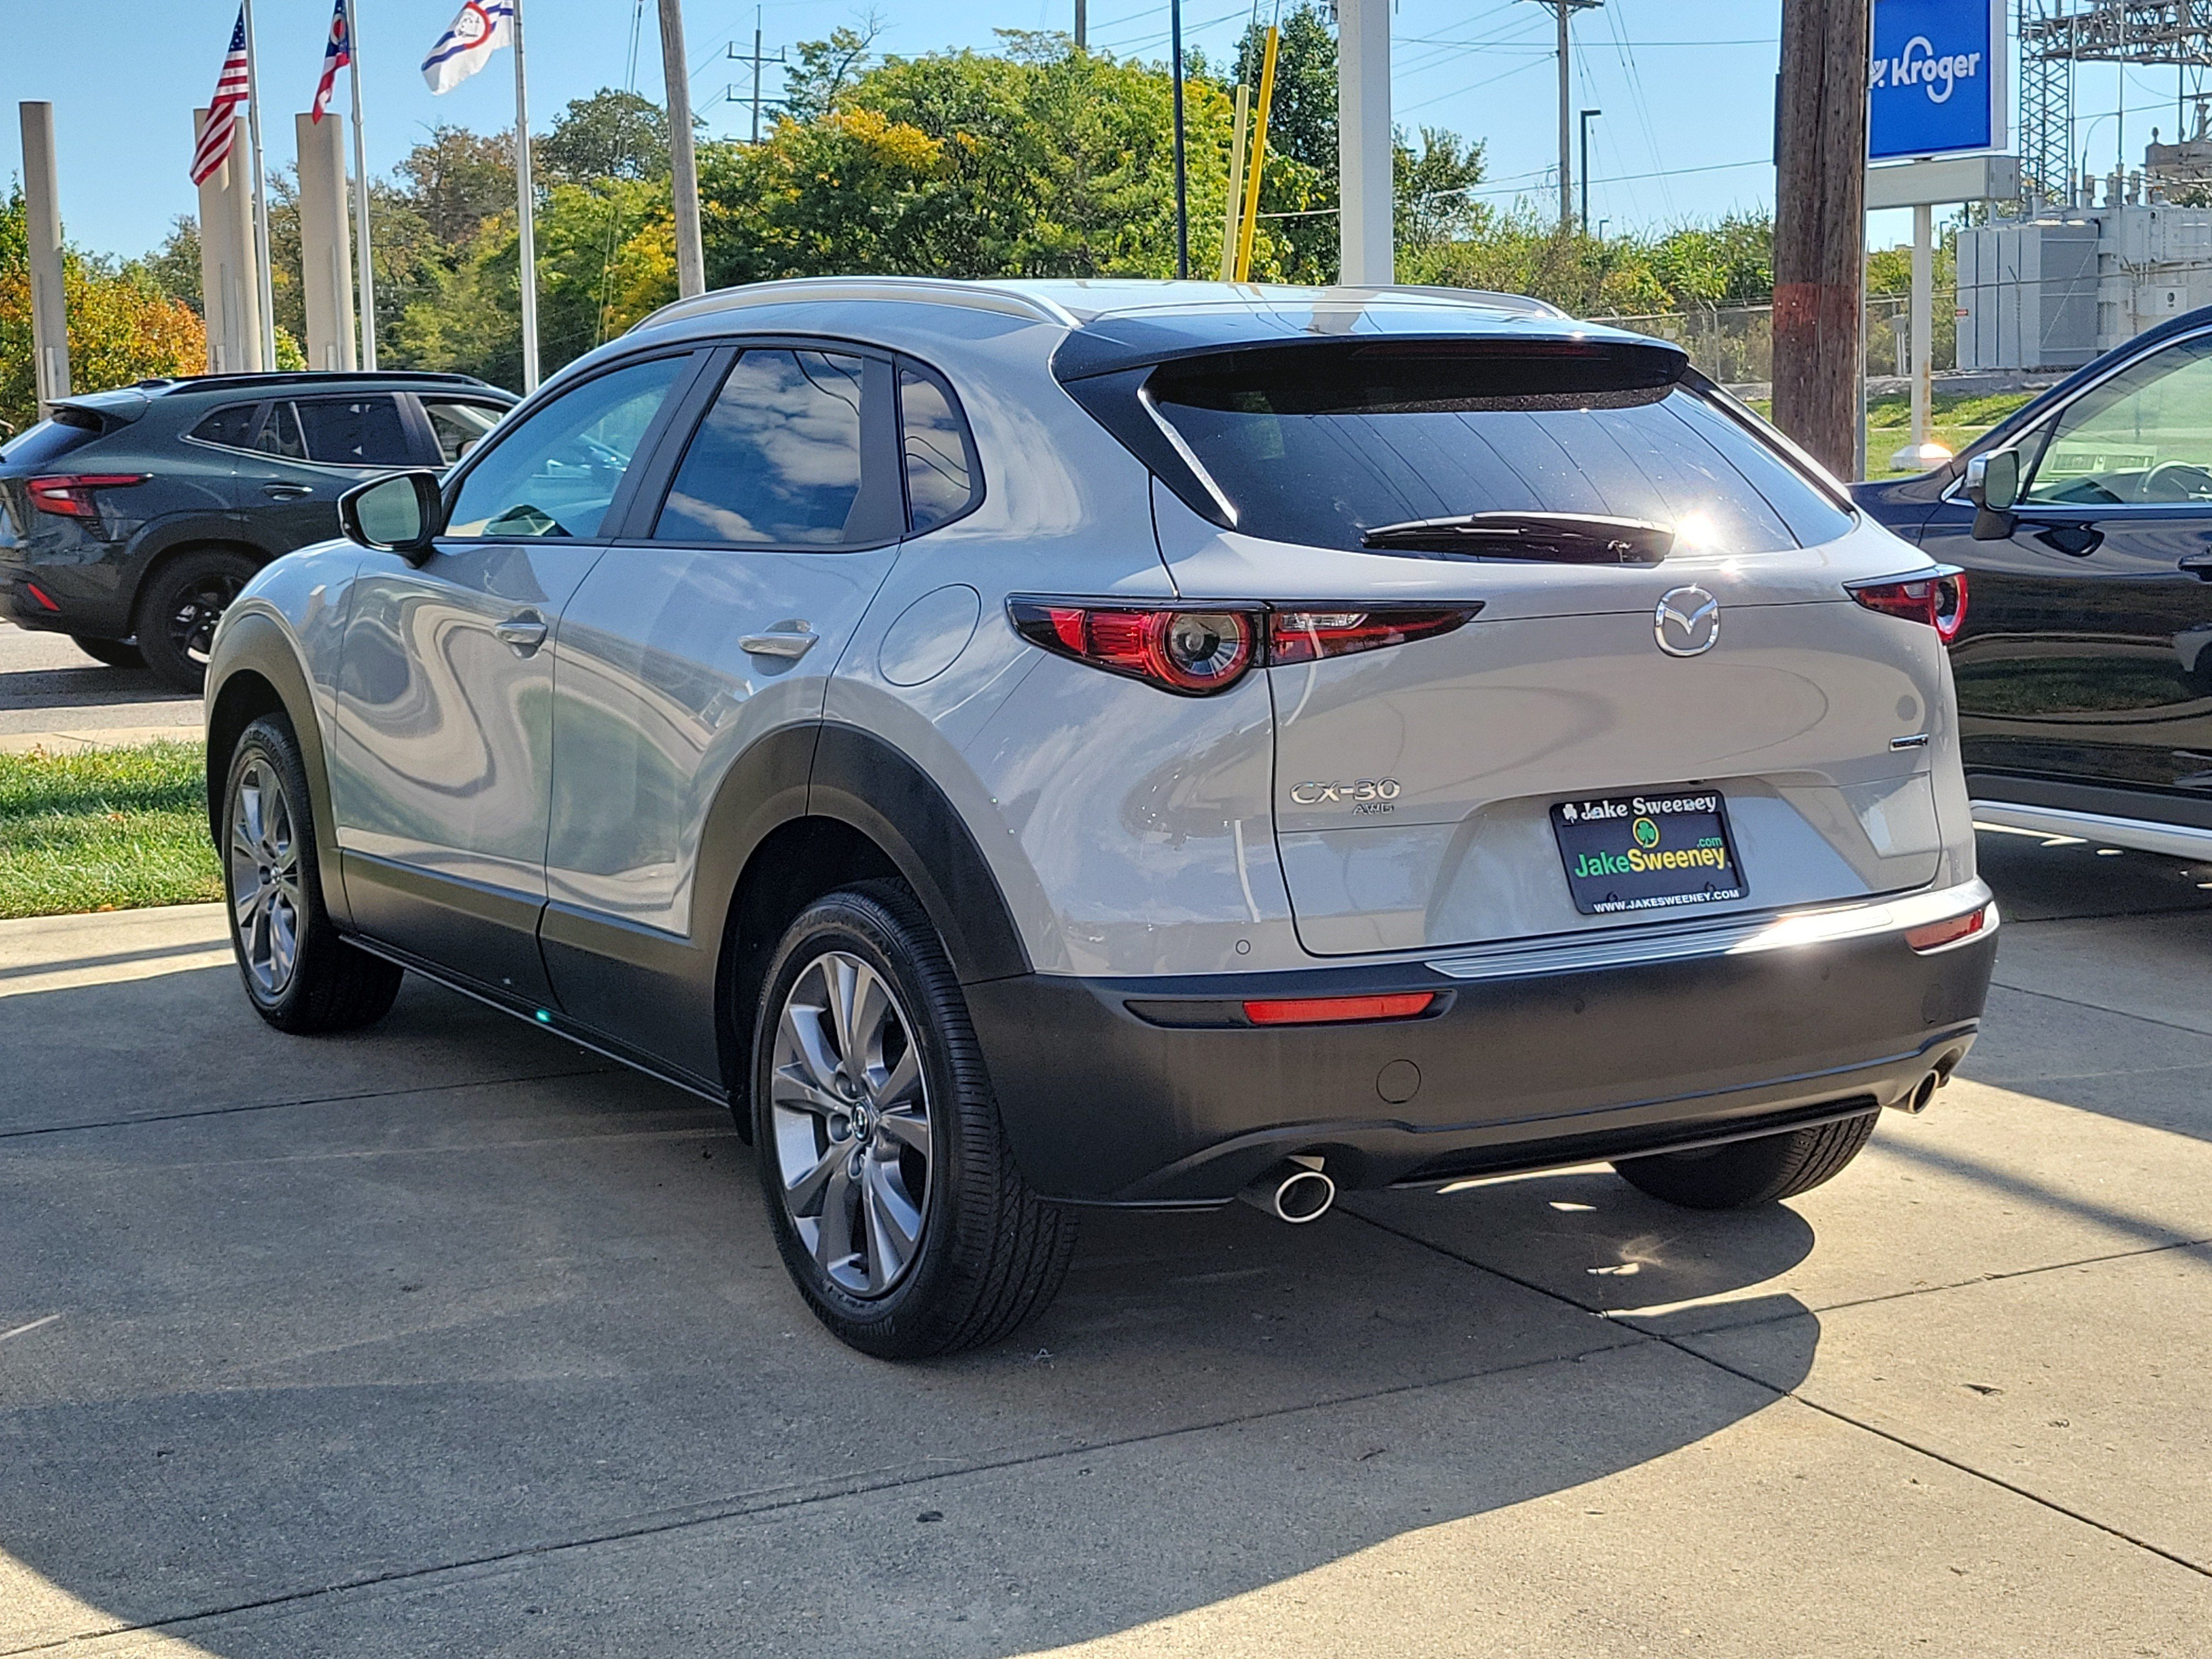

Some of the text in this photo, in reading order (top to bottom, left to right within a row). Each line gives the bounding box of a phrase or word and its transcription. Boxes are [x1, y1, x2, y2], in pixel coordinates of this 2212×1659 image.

[1892, 36, 1980, 103] Kroger
[1290, 777, 1401, 804] CX-30
[1581, 796, 1717, 820] Jake Sweeney
[1593, 889, 1740, 913] WWW.JAKESWEENEY.COM
